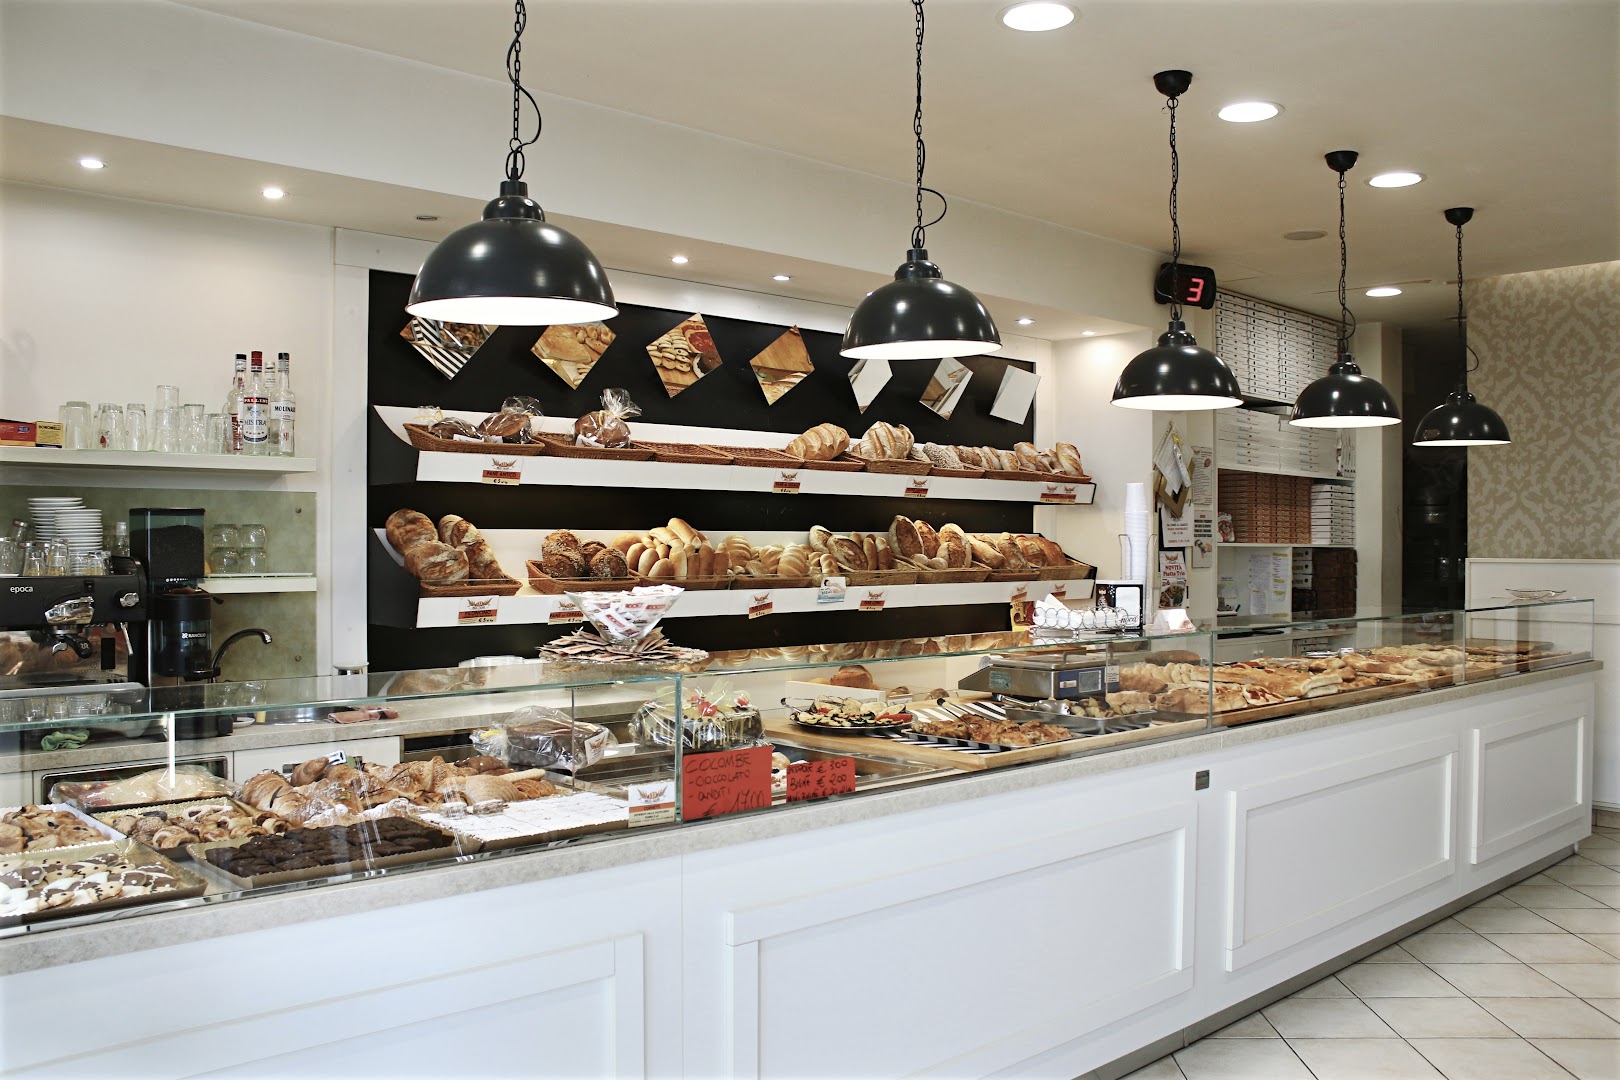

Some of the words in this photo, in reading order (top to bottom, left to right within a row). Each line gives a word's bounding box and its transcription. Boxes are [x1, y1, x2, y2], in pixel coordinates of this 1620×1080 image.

[1186, 278, 1205, 303] 3
[9, 586, 34, 595] epoca
[685, 752, 752, 774] COLOMBE
